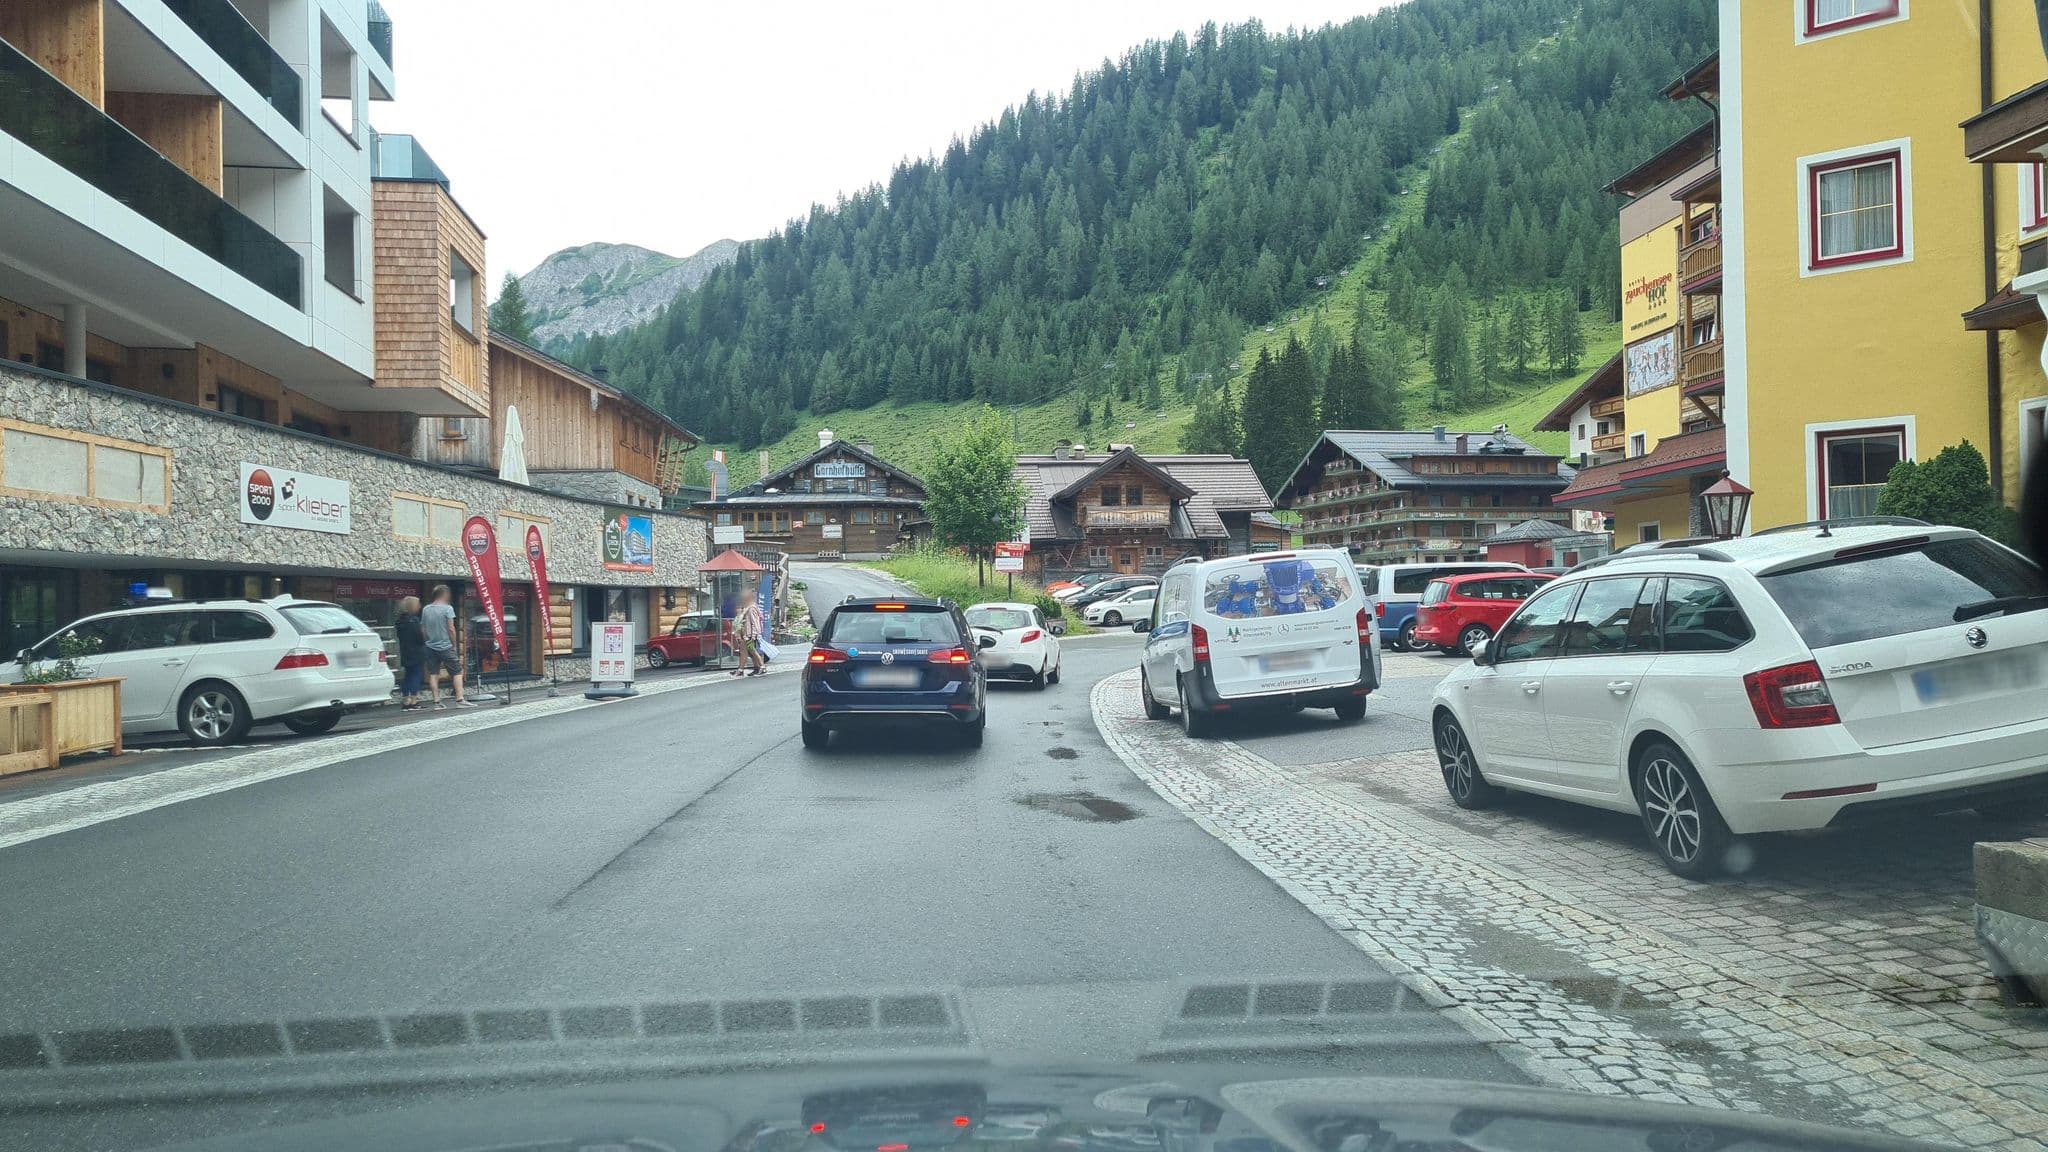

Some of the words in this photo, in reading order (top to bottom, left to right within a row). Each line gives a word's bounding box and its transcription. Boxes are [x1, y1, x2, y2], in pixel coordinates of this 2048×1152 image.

[1648, 282, 1667, 302] HOF
[249, 484, 273, 495] SPORT
[251, 495, 271, 506] 2000
